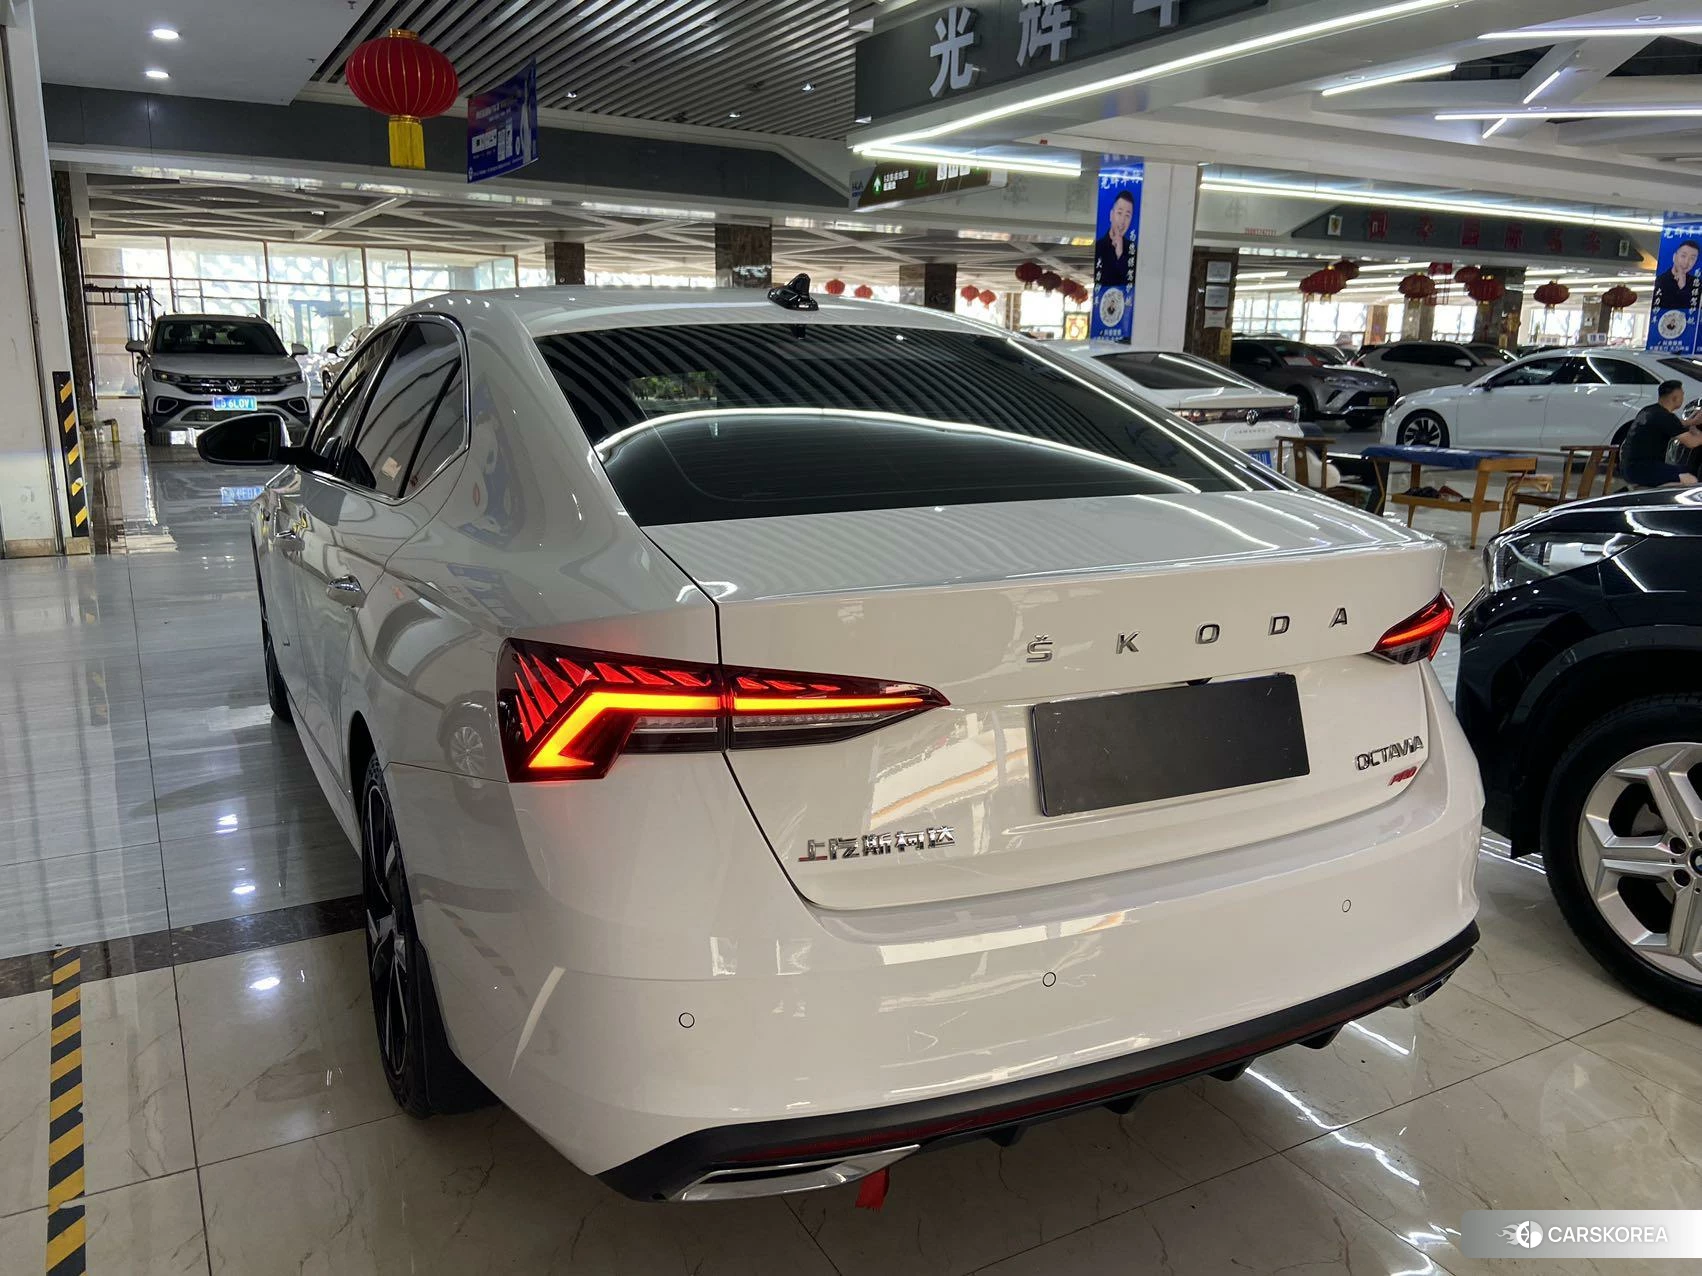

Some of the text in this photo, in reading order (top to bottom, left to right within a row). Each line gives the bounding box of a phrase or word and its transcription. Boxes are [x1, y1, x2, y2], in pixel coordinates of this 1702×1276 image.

[1026, 607, 1349, 663] ŠKODA
[1355, 735, 1424, 771] OCTAVIA
[798, 825, 956, 863] 上汽斯柯达
